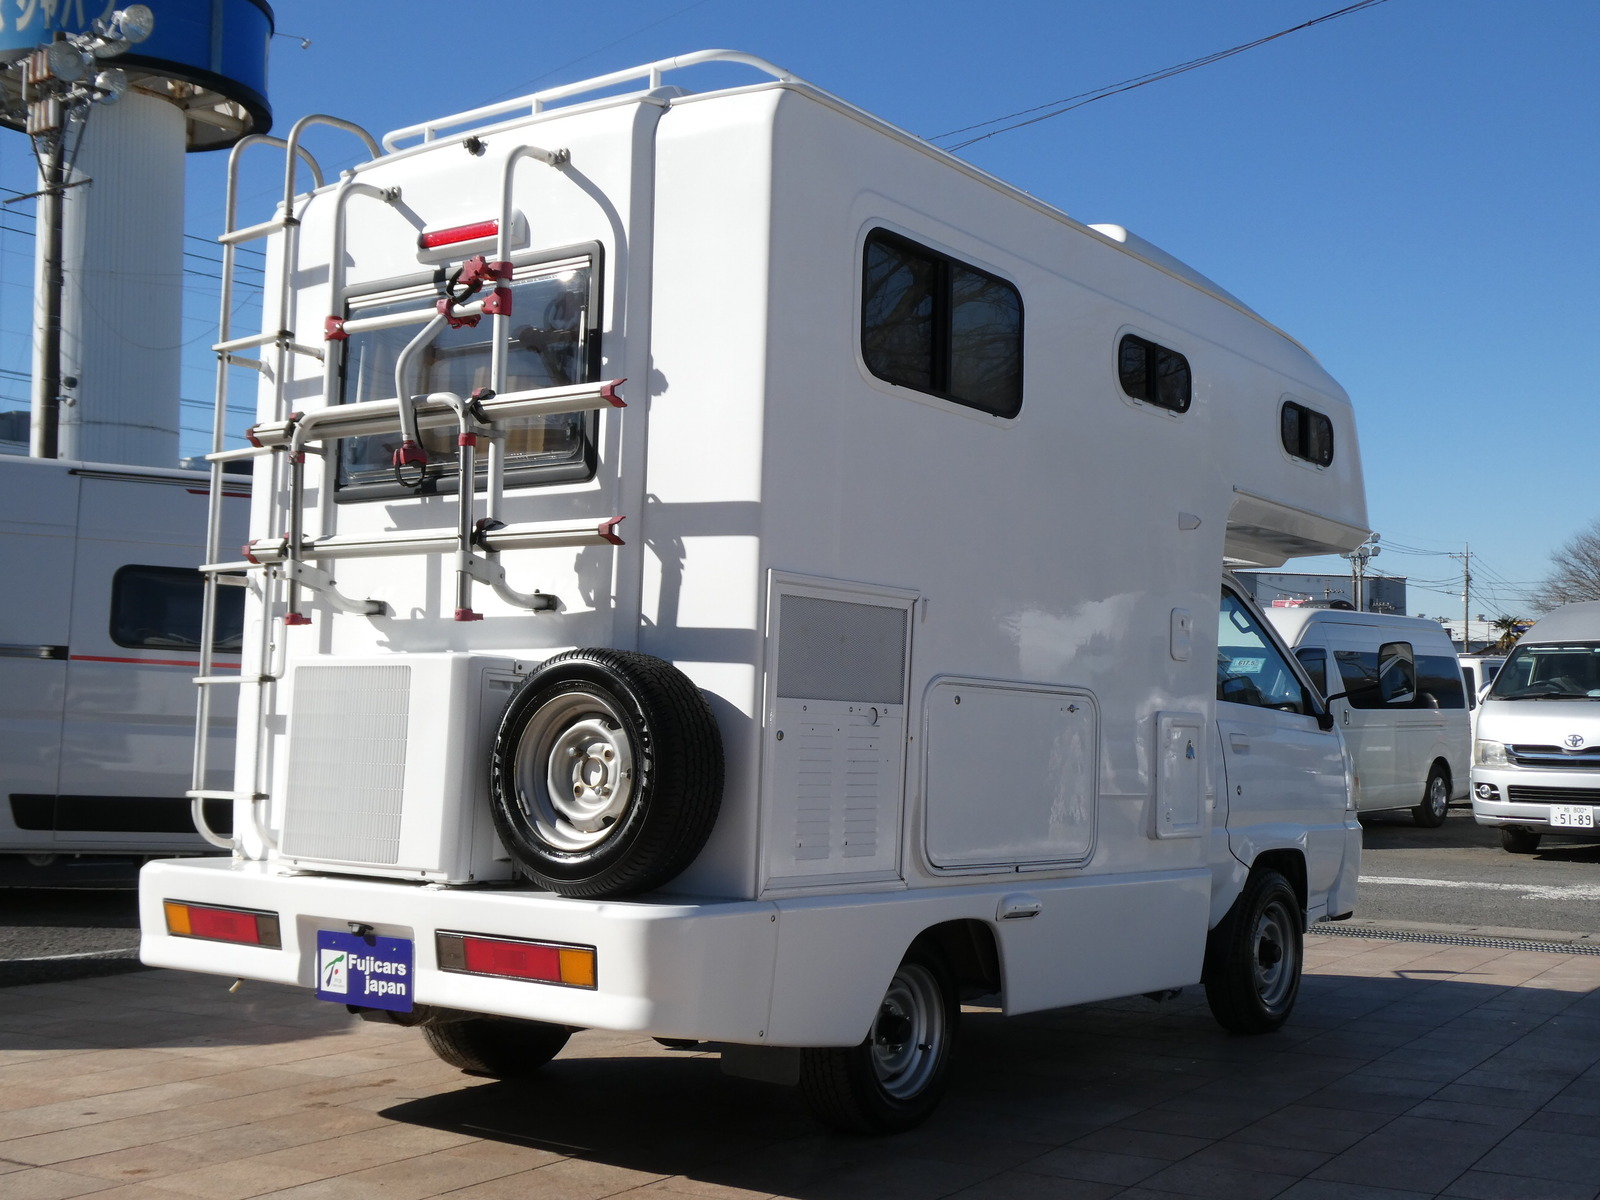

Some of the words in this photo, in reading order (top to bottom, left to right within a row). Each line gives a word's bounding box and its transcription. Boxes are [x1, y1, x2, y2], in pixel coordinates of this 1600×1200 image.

[1560, 813, 1591, 826] 51-89
[348, 954, 407, 976] Fujicars
[364, 975, 406, 996] japan
